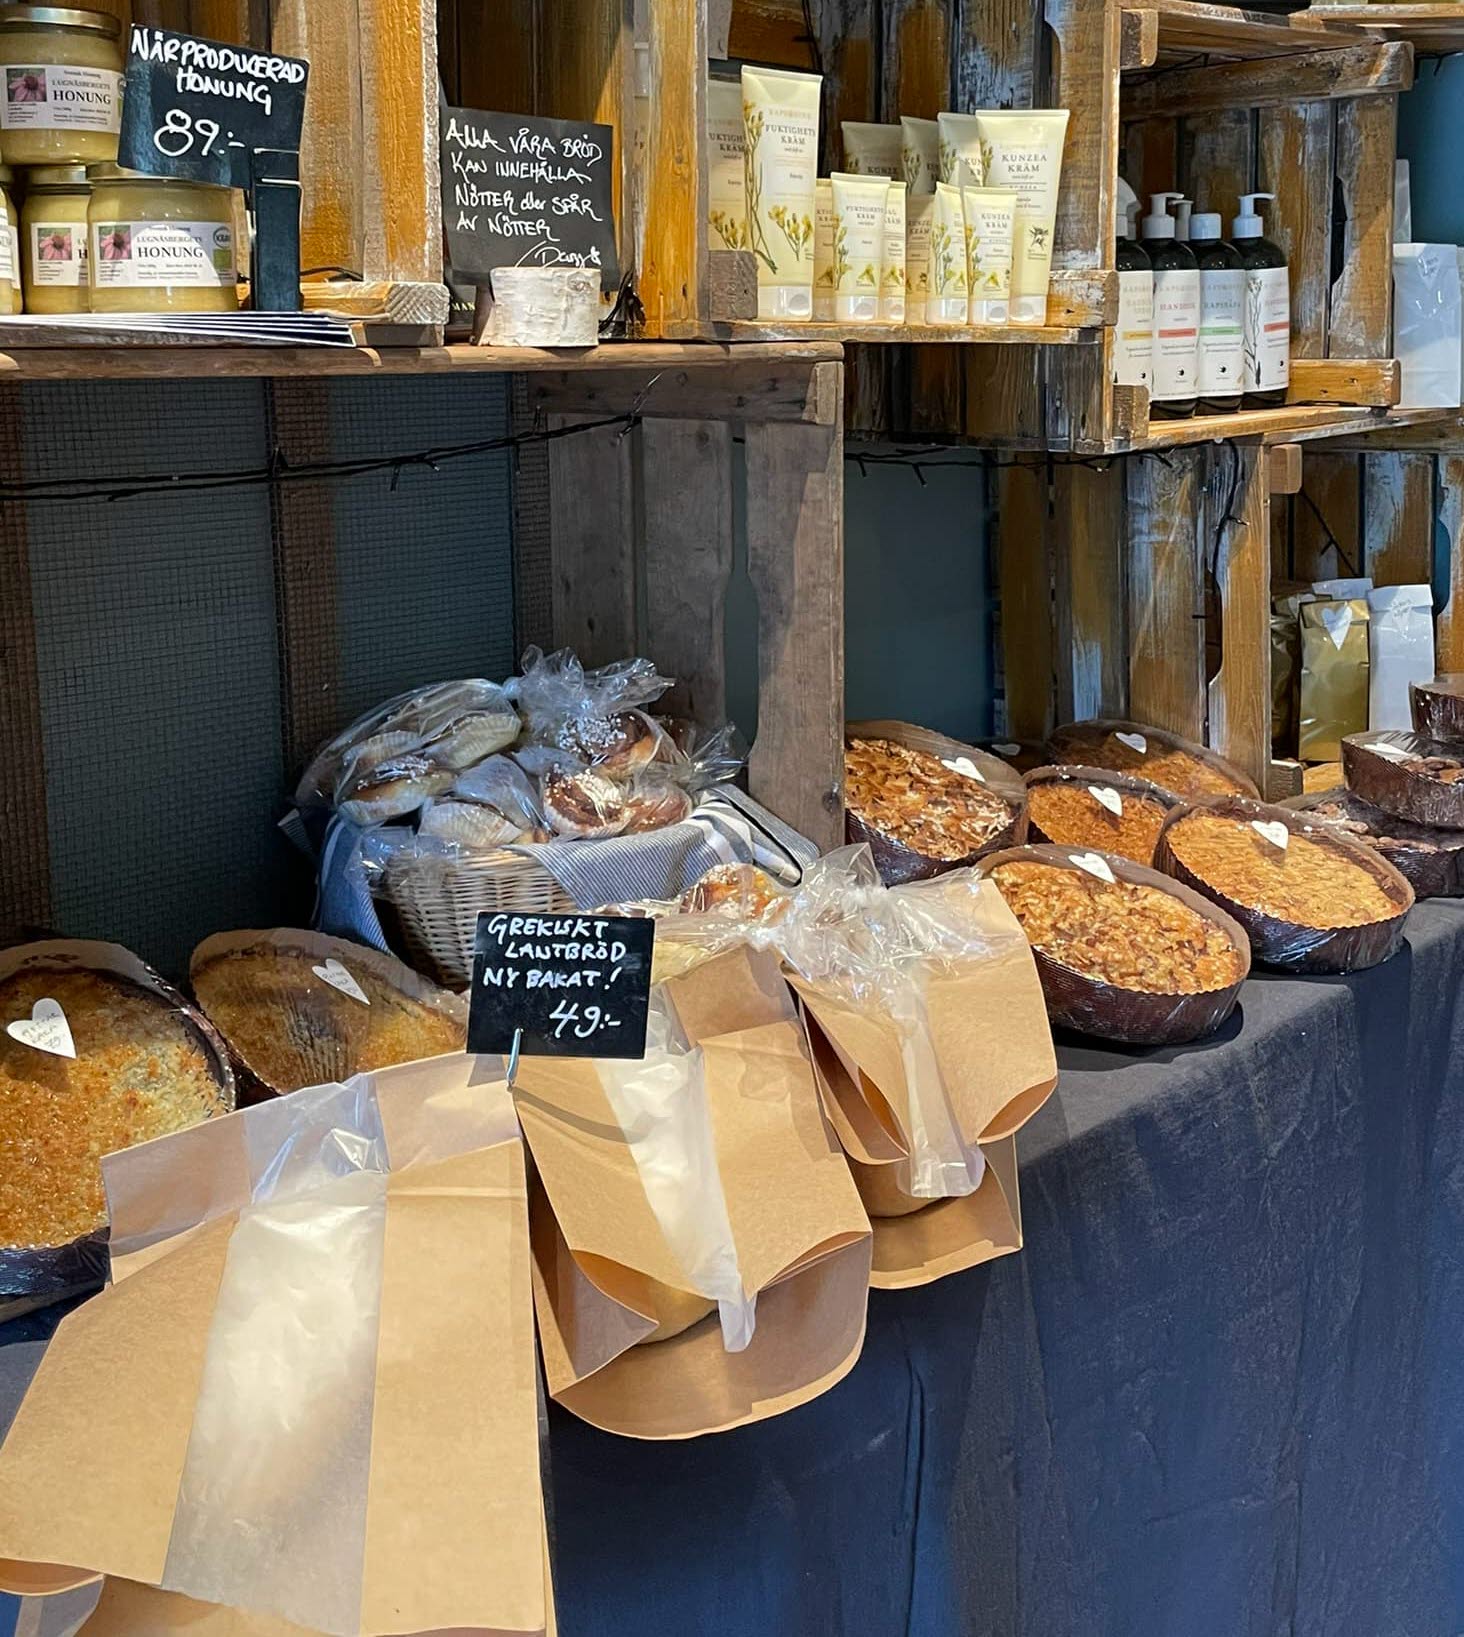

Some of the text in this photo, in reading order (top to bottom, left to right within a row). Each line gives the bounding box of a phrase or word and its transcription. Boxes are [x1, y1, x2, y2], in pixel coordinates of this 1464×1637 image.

[131, 28, 306, 84] NÄRPRODUCERAD
[53, 90, 111, 104] HONUNG
[176, 67, 272, 115] HONUNG
[154, 109, 245, 156] 89:-
[446, 118, 602, 167] ALLA VÅRA BRÖD
[781, 136, 806, 145] KRÄM
[451, 151, 592, 185] KAN INNEHÅLLA
[1002, 154, 1047, 162] KUNZEA
[1008, 163, 1040, 172] KRÄM
[455, 183, 518, 215] NÖTTER
[552, 193, 603, 221] SPÅR
[456, 211, 560, 242] AV NÖTTER
[138, 246, 203, 259] HONUNG
[487, 914, 609, 944] GREKISKT
[504, 941, 626, 963] LANTBRÖD
[483, 967, 520, 989] NY
[549, 1000, 621, 1039] 49:-
